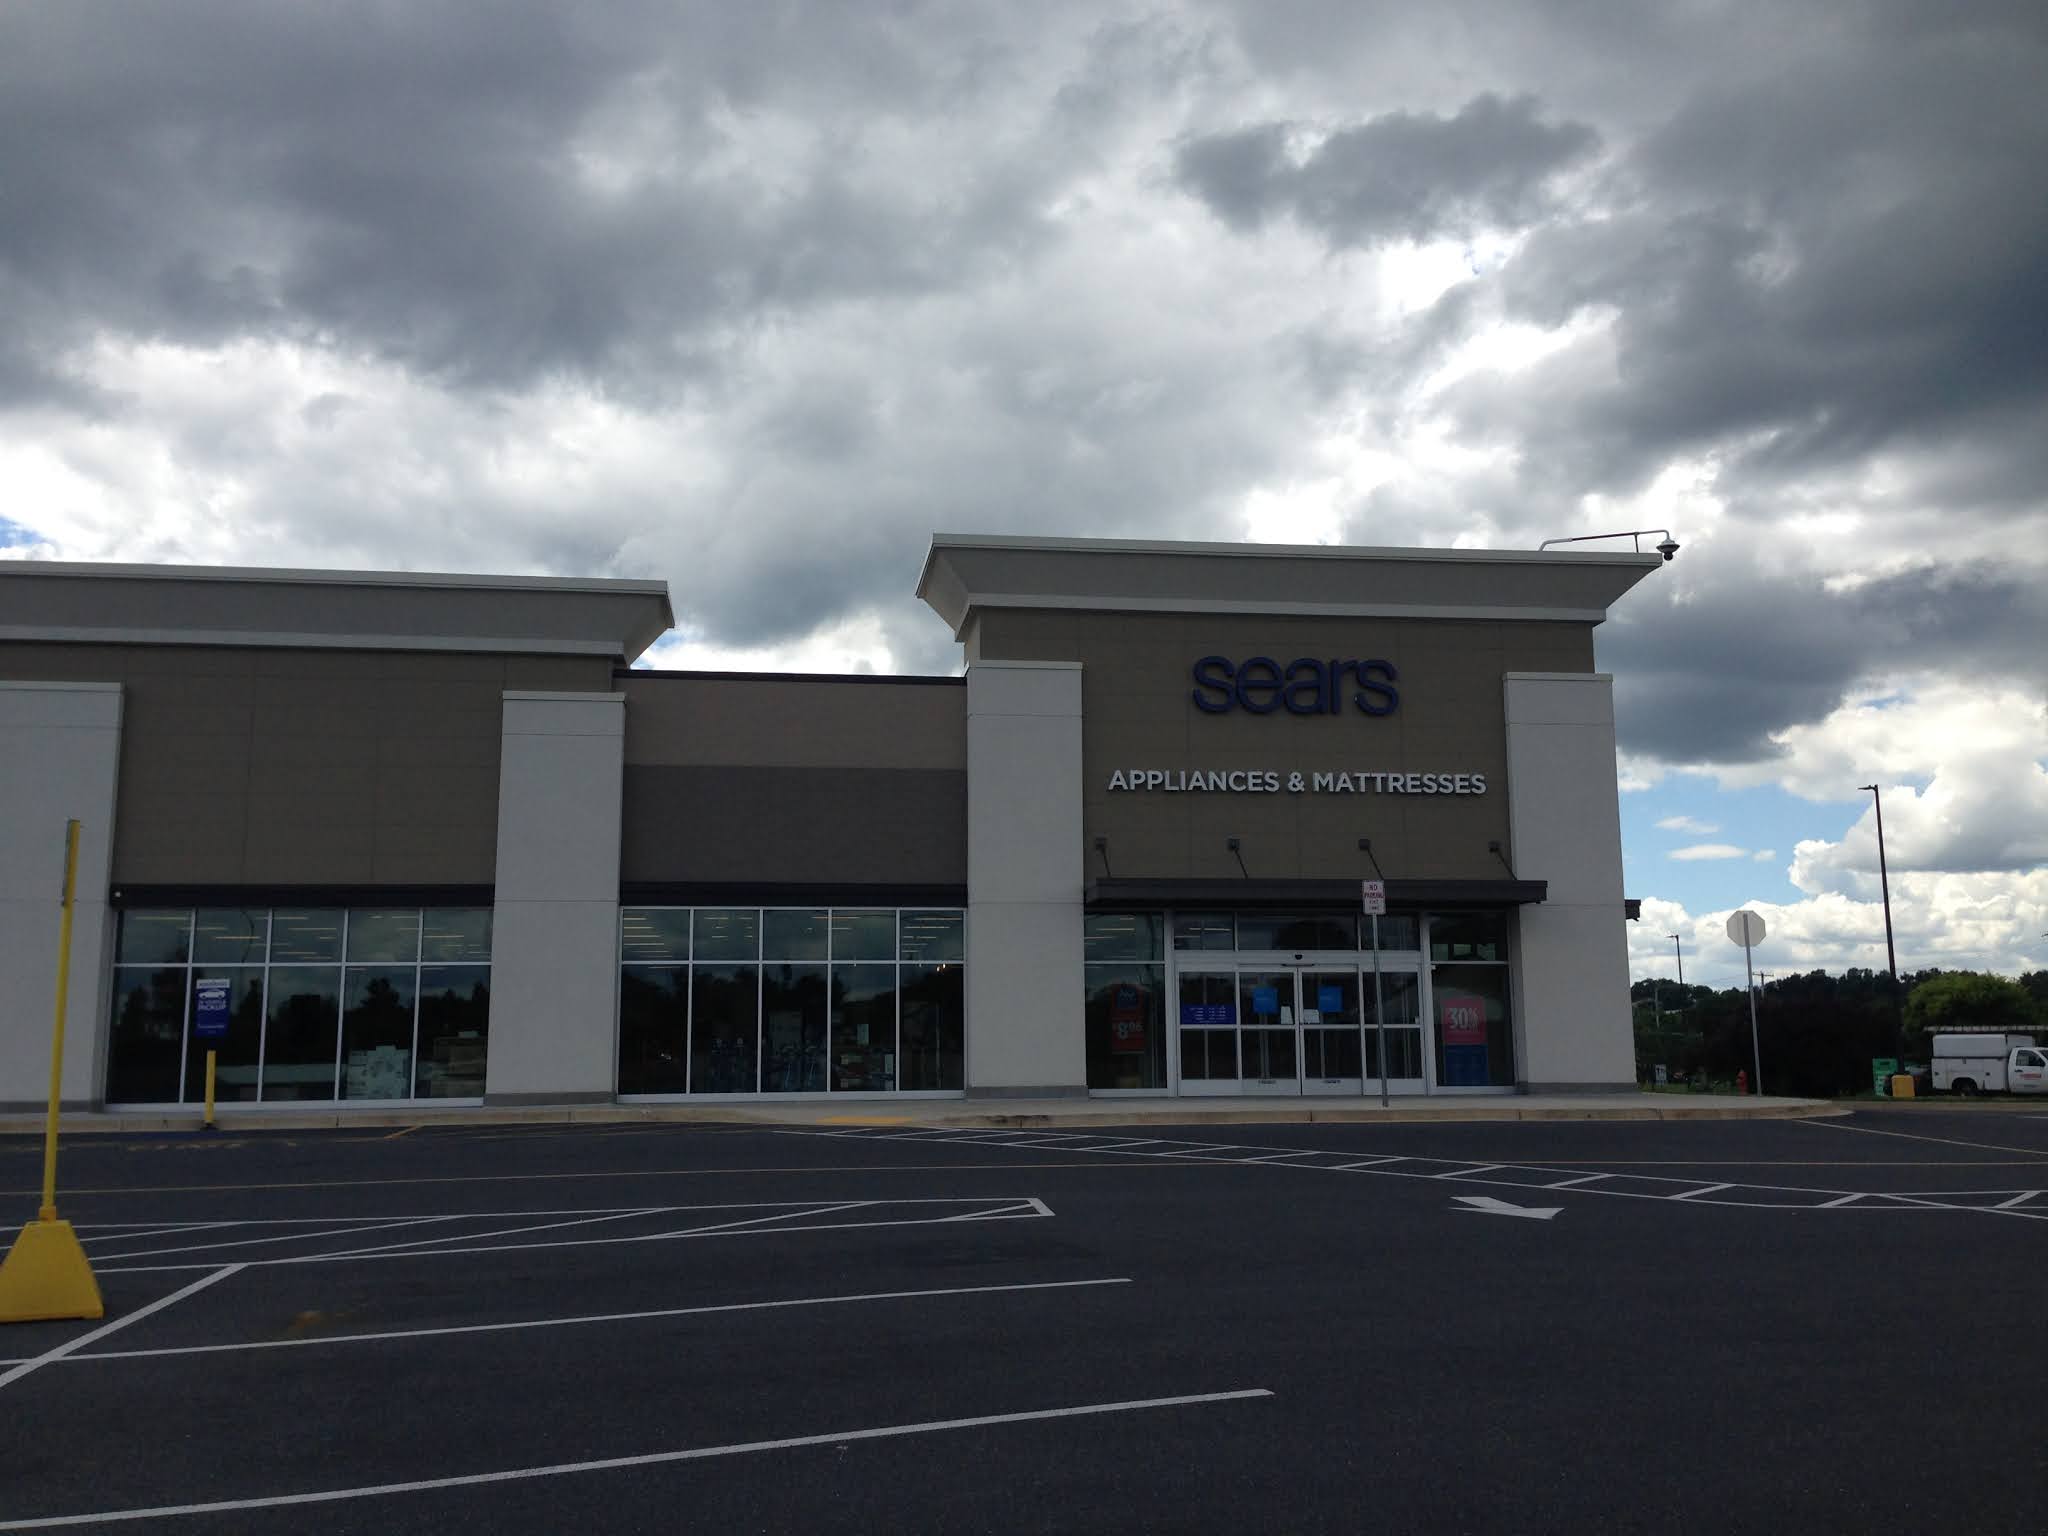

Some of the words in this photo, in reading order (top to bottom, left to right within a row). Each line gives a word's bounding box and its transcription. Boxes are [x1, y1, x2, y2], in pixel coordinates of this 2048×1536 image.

[1192, 655, 1399, 716] sears
[1108, 769, 1280, 793] APPLIANCES
[1287, 772, 1306, 793] &
[1314, 771, 1487, 795] MATTRESSES
